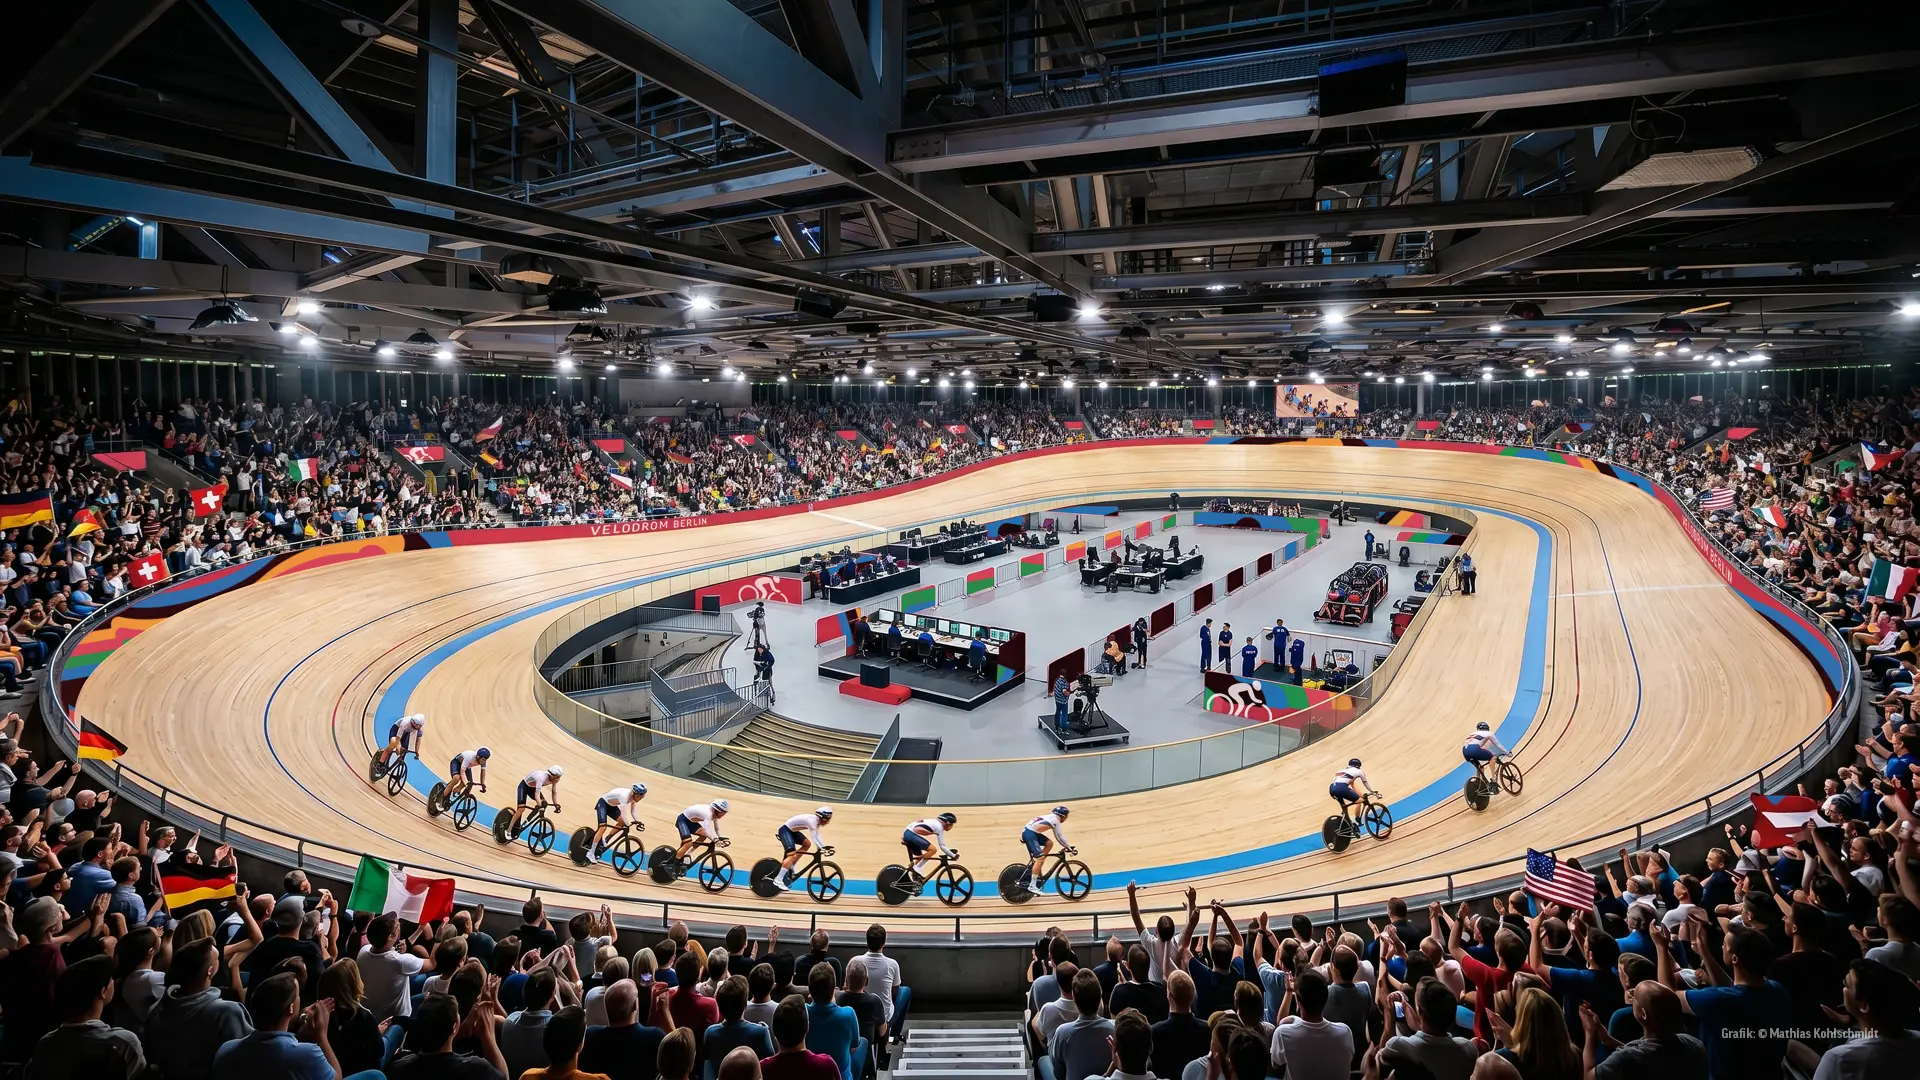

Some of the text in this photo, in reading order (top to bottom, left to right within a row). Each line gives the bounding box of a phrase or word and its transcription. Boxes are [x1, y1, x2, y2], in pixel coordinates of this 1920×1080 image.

[591, 518, 707, 536] VELODROM BERLIN
[1710, 548, 1733, 584] BERLIN
